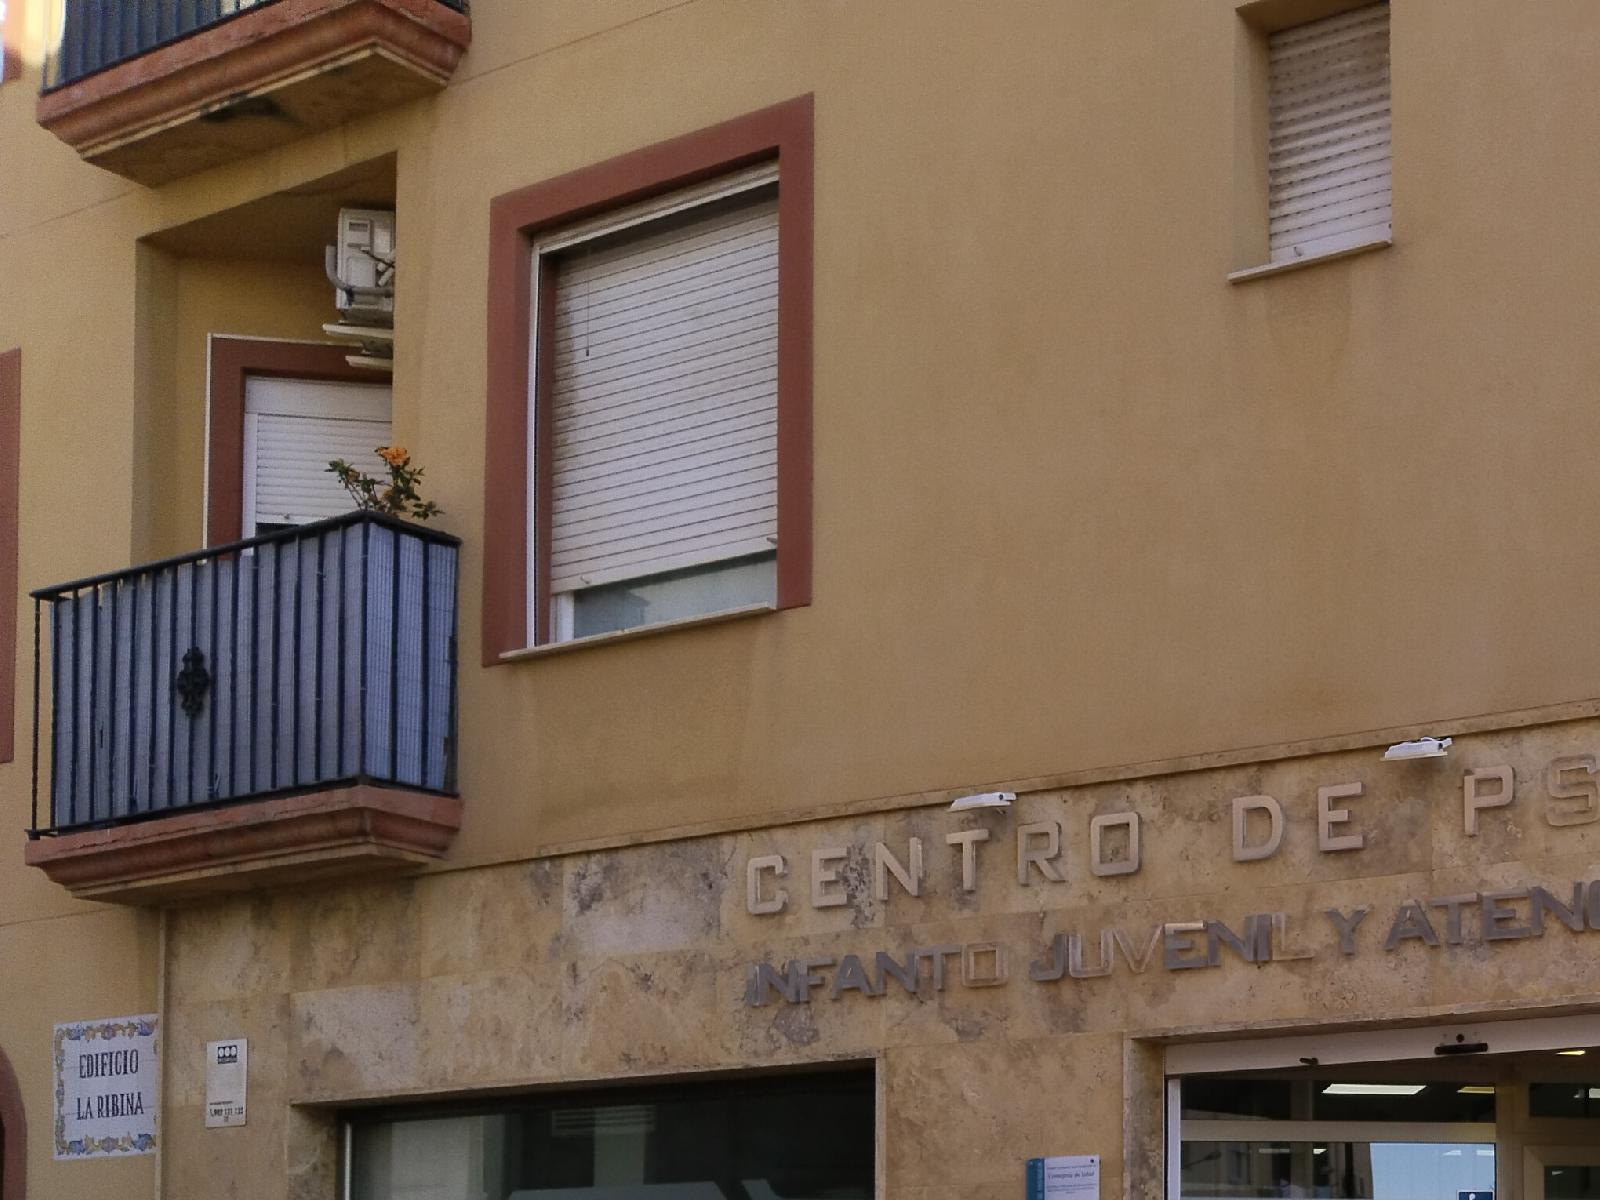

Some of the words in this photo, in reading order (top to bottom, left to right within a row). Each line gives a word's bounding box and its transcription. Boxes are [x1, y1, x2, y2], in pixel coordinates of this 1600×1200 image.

[746, 811, 1142, 916] CENTRO
[1231, 781, 1366, 863] DE
[747, 941, 1008, 1006] INFANTO
[1029, 911, 1314, 982] JUVENIL
[1324, 904, 1375, 956] Y
[79, 1048, 139, 1079] EDIFICIO
[76, 1096, 94, 1120] LA
[97, 1091, 144, 1119] RIBINA
